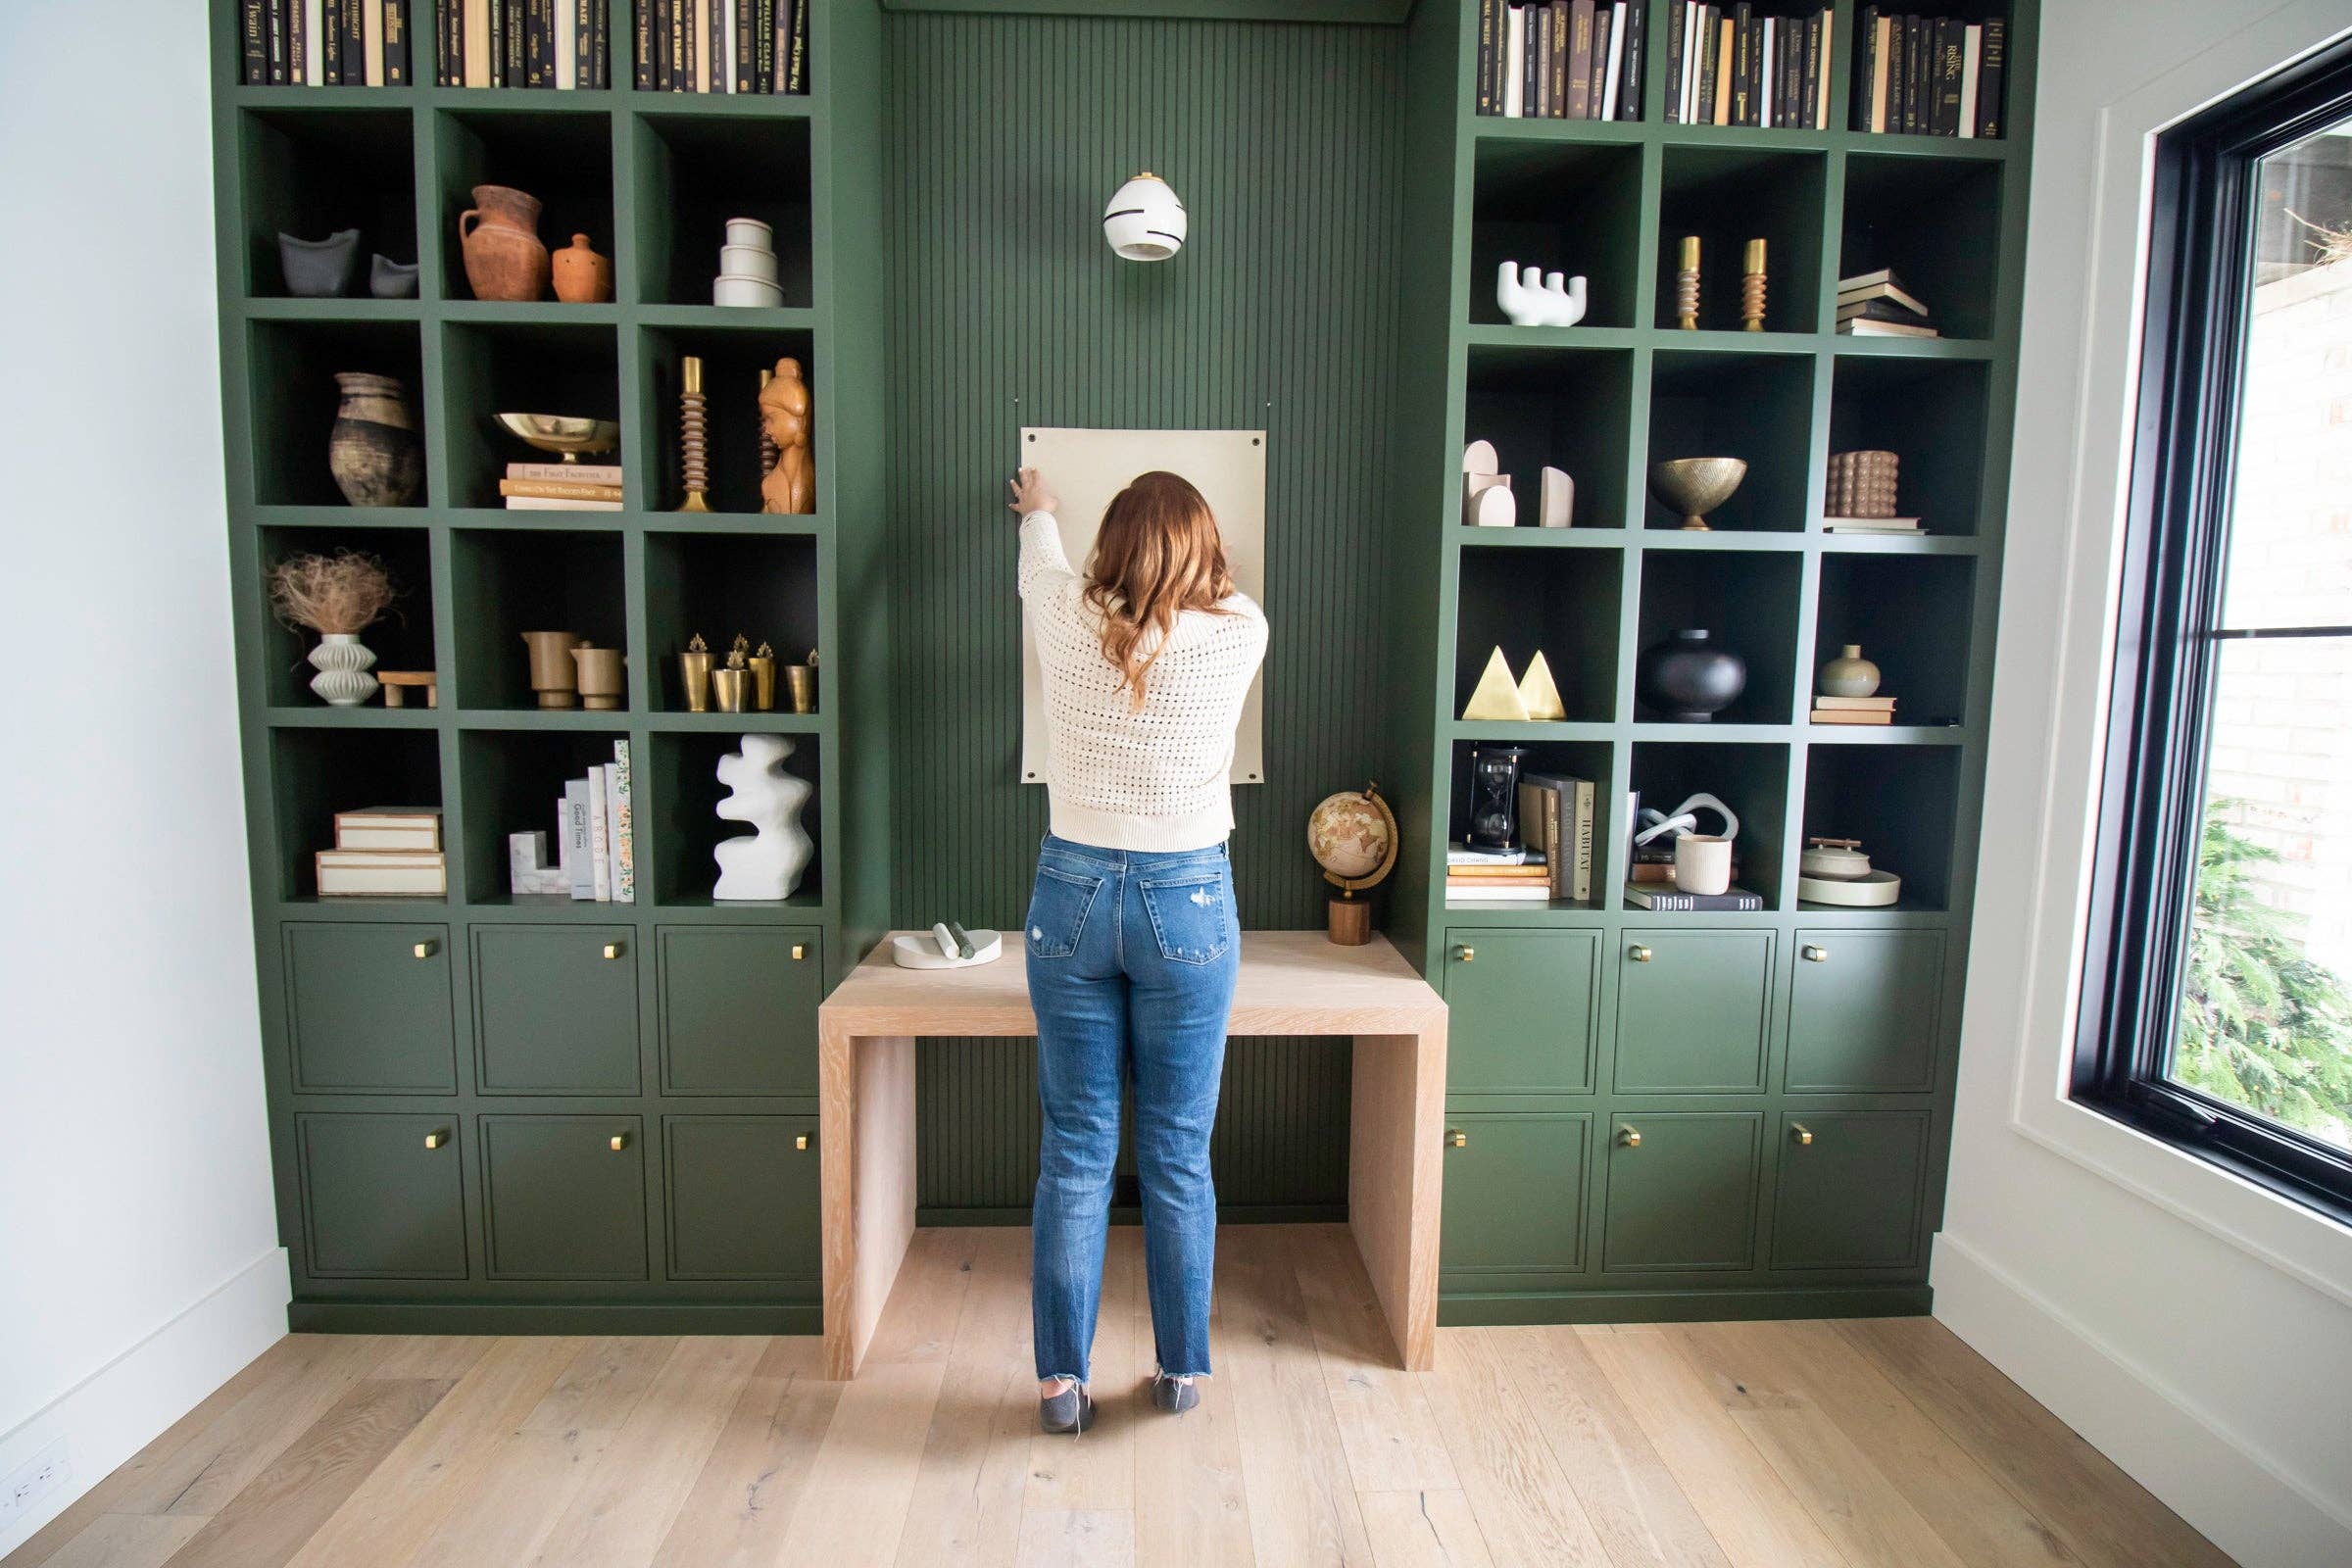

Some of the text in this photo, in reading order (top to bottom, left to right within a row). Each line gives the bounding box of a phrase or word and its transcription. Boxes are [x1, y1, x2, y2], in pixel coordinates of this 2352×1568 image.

[248, 2, 262, 37] Twain
[1945, 45, 1957, 80] RISING
[790, 76, 799, 91] The
[573, 804, 582, 826] Good
[1580, 819, 1592, 871] HABITAT
